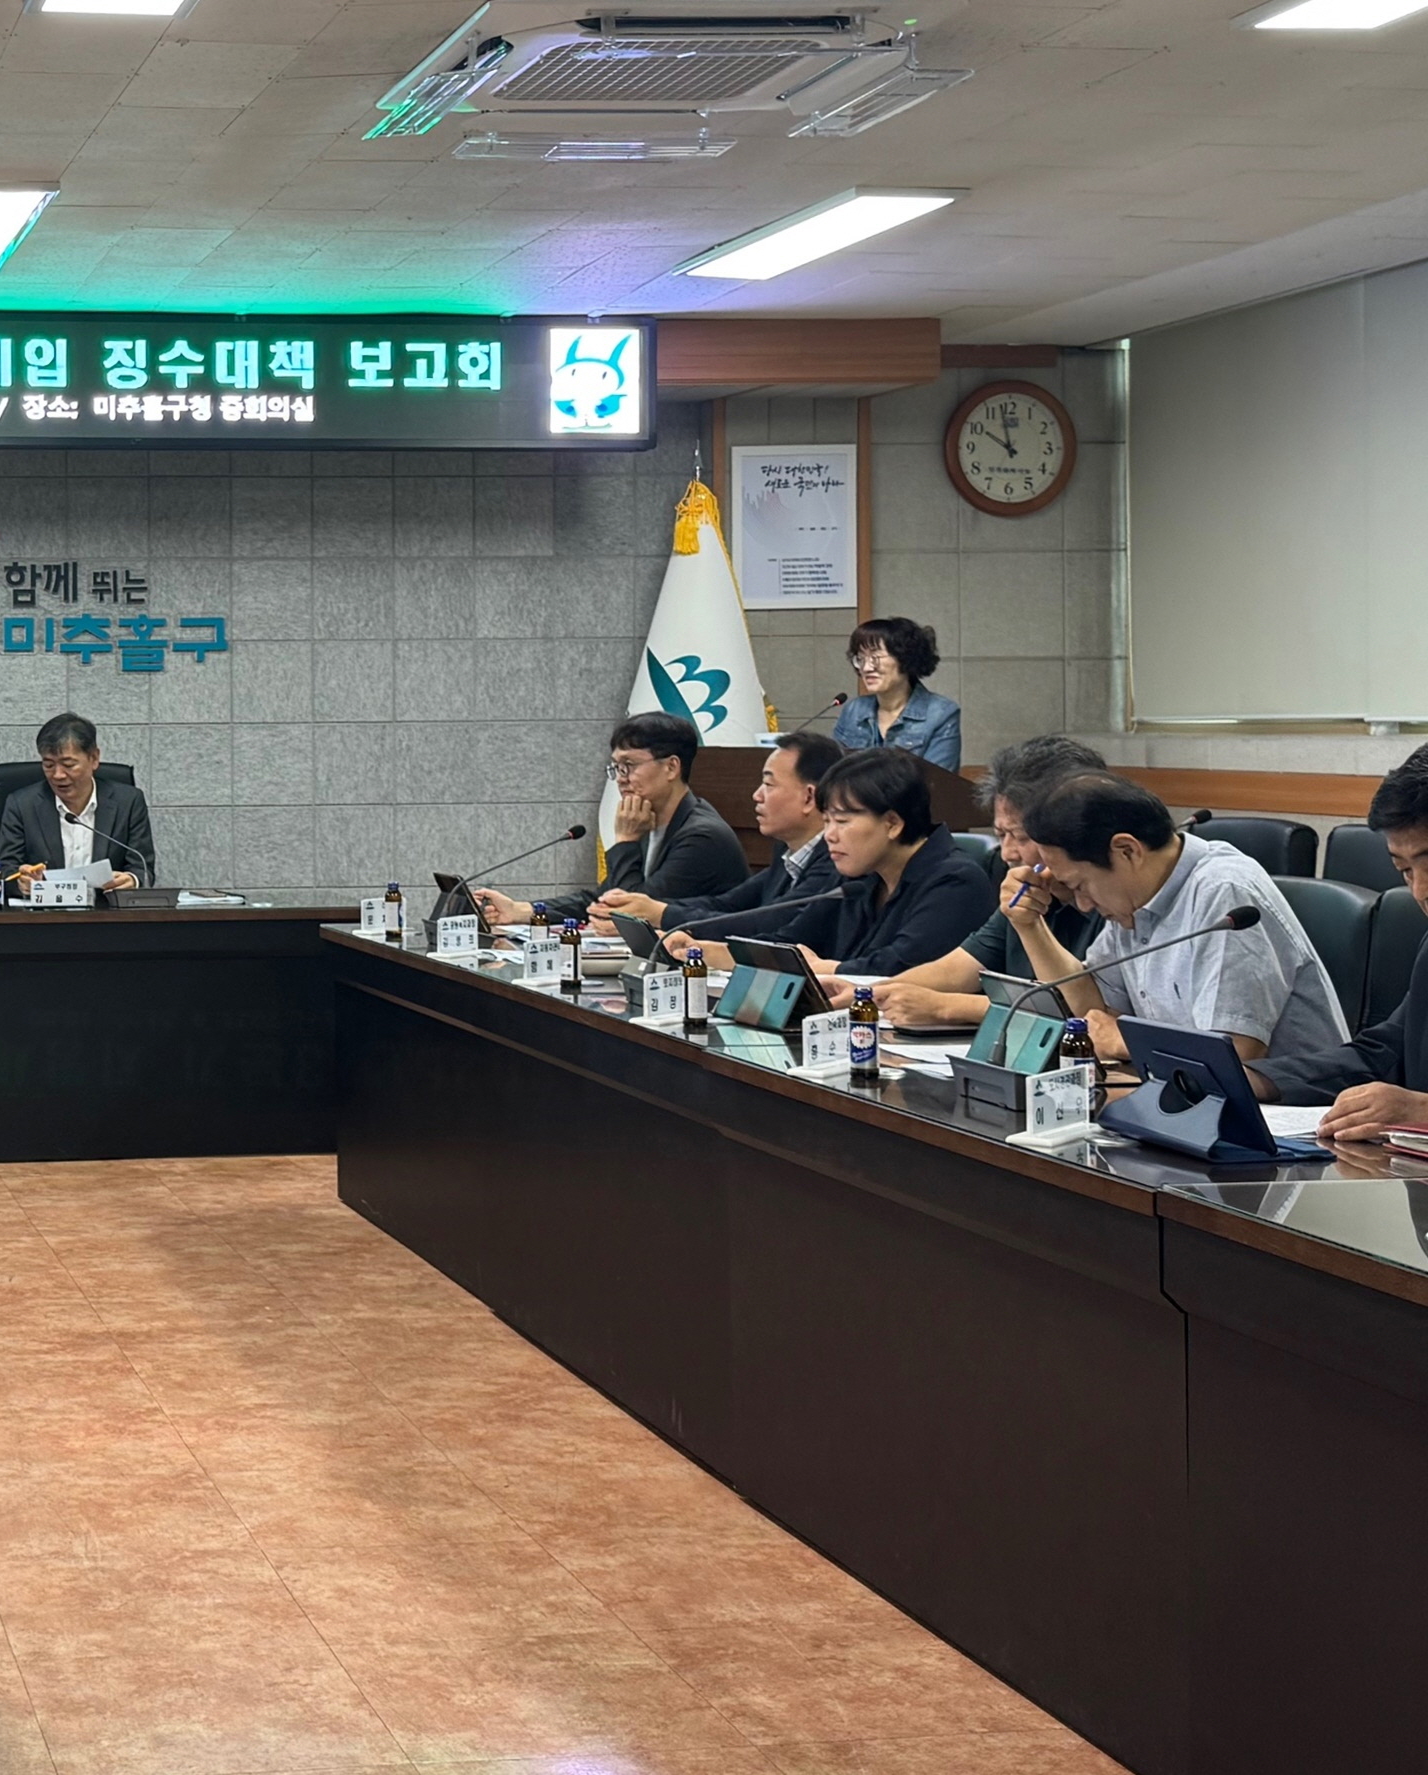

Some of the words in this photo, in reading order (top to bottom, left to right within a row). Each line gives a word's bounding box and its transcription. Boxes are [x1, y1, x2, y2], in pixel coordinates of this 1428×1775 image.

[102, 340, 316, 390] 징수대책
[347, 341, 503, 391] 보고회
[23, 394, 79, 420] 장소:
[93, 394, 212, 421] 미추홀구청
[986, 407, 995, 420] 11
[1004, 402, 1017, 415] 12
[1028, 407, 1032, 420] 1
[970, 422, 984, 435] 10
[1040, 422, 1048, 435] 2
[966, 442, 975, 455] 9
[1043, 442, 1053, 455] 3
[761, 464, 782, 476] 다시
[970, 462, 981, 475] 8
[1038, 462, 1047, 475] 4
[984, 477, 992, 490] 7
[1004, 482, 1013, 495] 6
[1024, 477, 1033, 490] 5
[3, 561, 79, 608] 함께
[91, 569, 148, 604] 뛰는
[2, 613, 229, 674] 미추홀구
